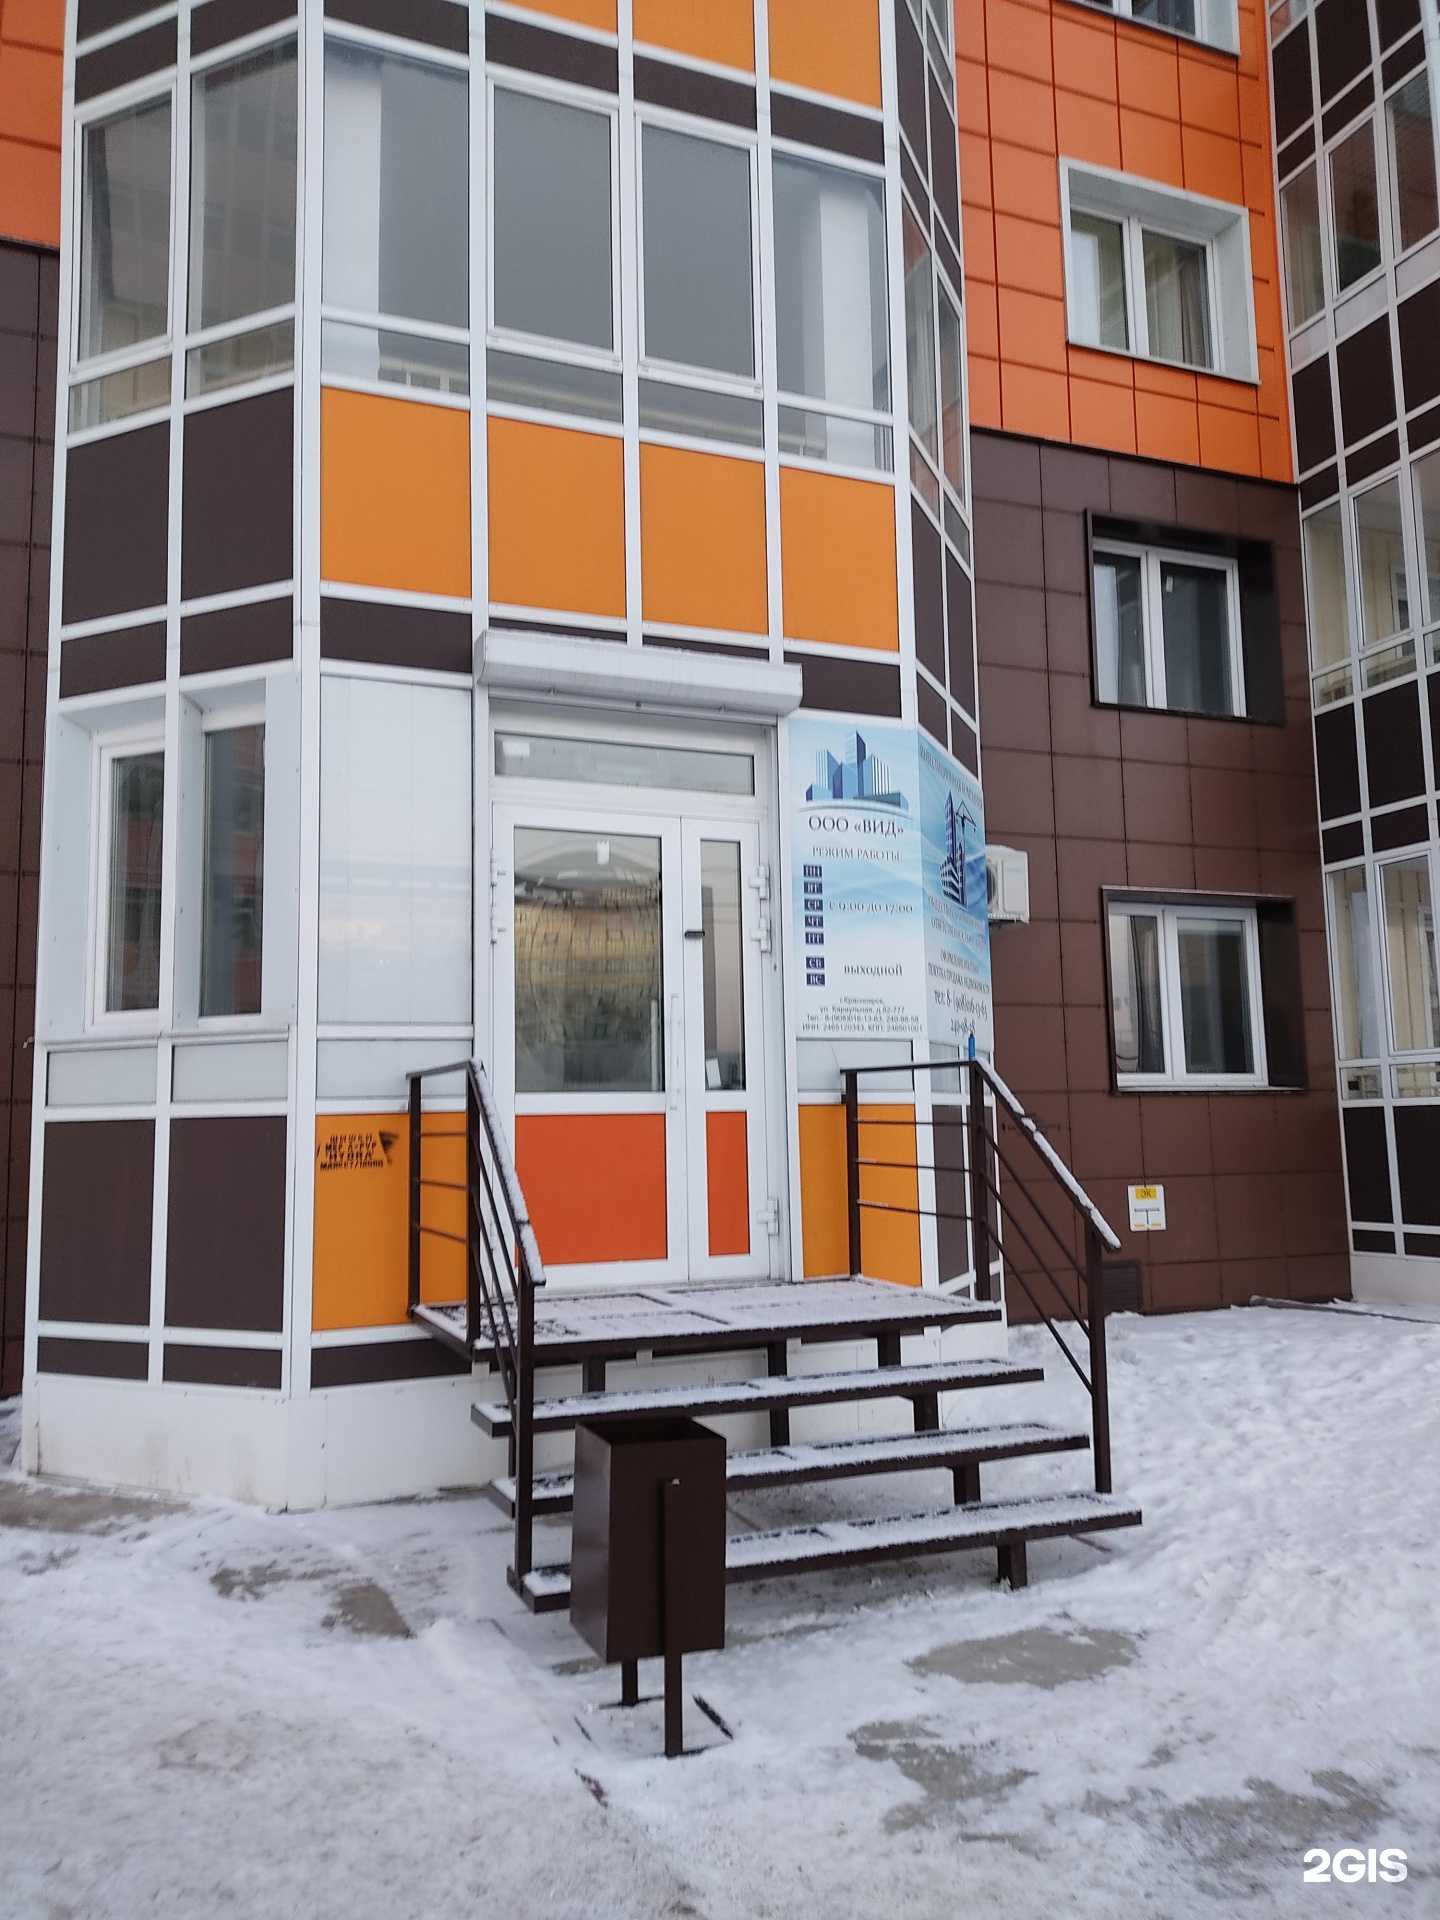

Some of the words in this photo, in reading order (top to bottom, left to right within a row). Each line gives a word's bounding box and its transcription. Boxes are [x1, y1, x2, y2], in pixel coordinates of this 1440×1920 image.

[809, 815, 848, 832] ООО
[854, 817, 904, 838] «ВИД»
[812, 846, 853, 860] РЕЖИМ
